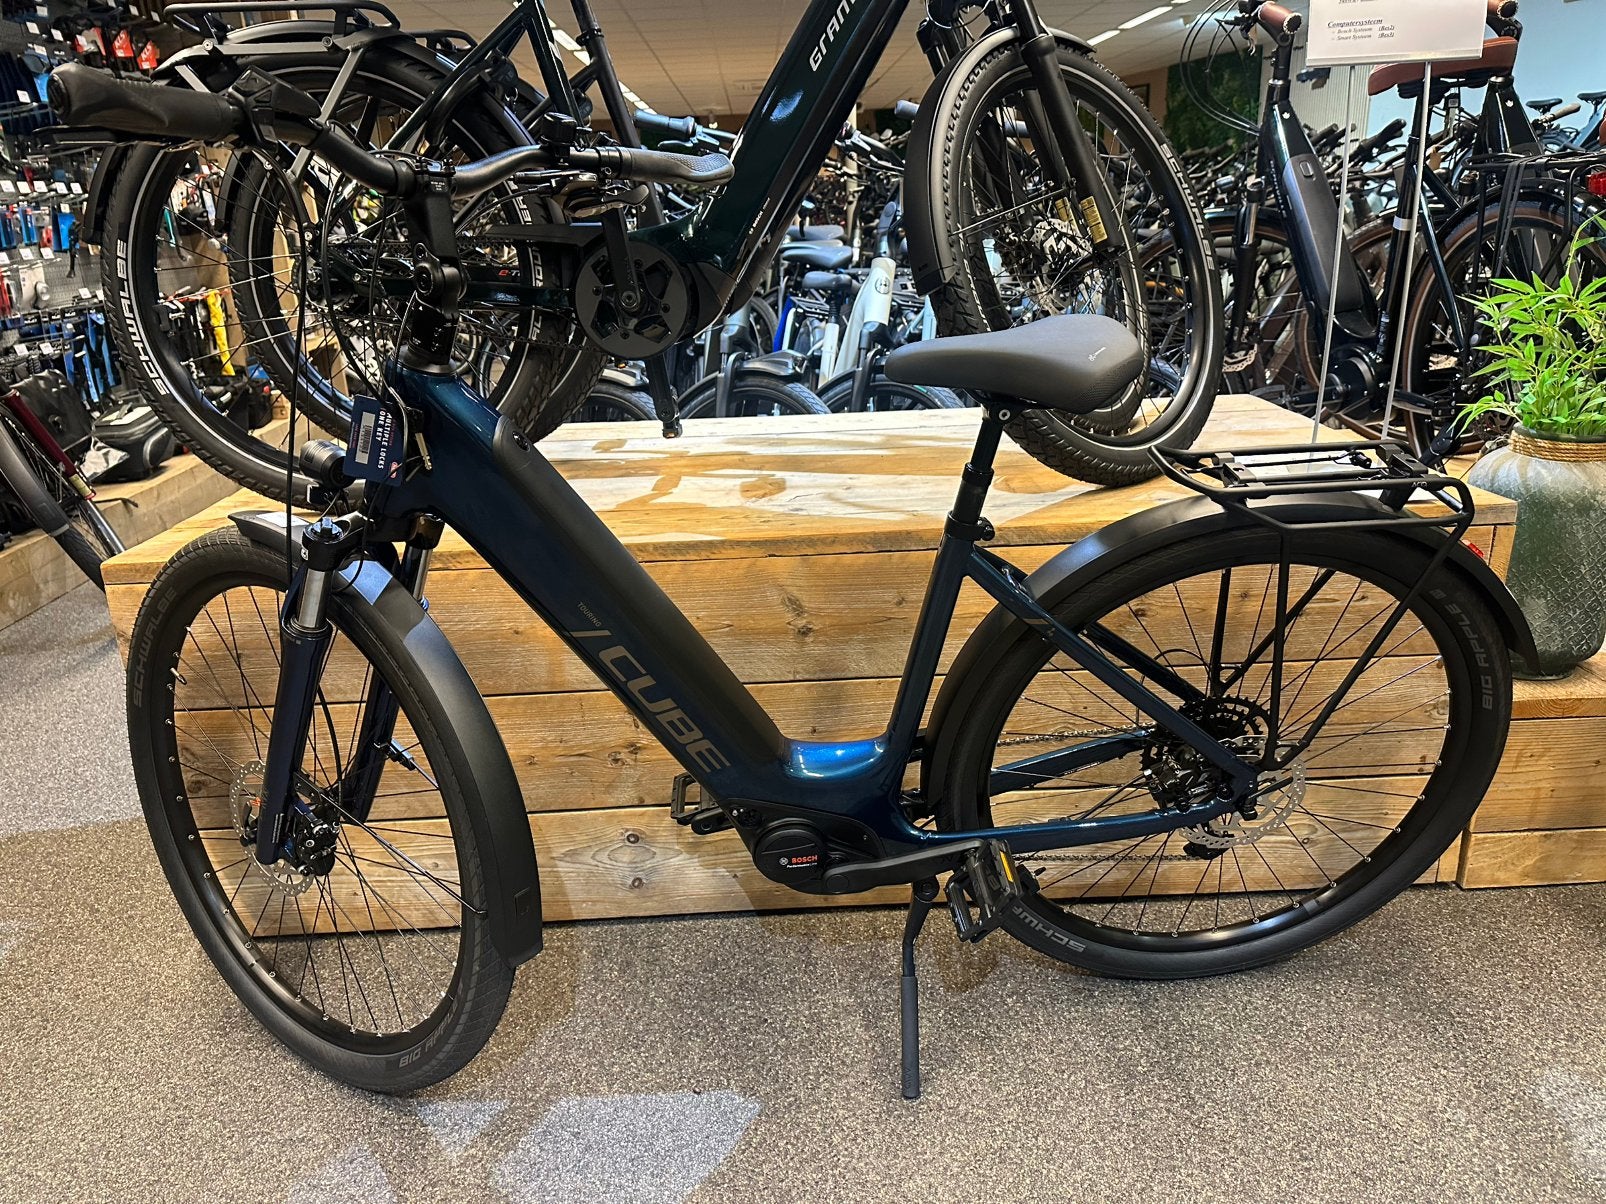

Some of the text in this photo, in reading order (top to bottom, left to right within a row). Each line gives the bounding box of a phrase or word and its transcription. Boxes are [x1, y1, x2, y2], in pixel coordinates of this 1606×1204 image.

[1160, 143, 1215, 271] SCHWALBE
[116, 239, 170, 396] SCHWALBE
[376, 410, 386, 426] ONE
[377, 447, 387, 470] LOCKS
[133, 586, 178, 708] SCHWALBE
[577, 601, 602, 627] TOURING
[1444, 603, 1494, 711] BIG APPLE
[598, 645, 731, 773] CUBE
[791, 855, 818, 864] BOSCH
[398, 1046, 422, 1069] BIG
